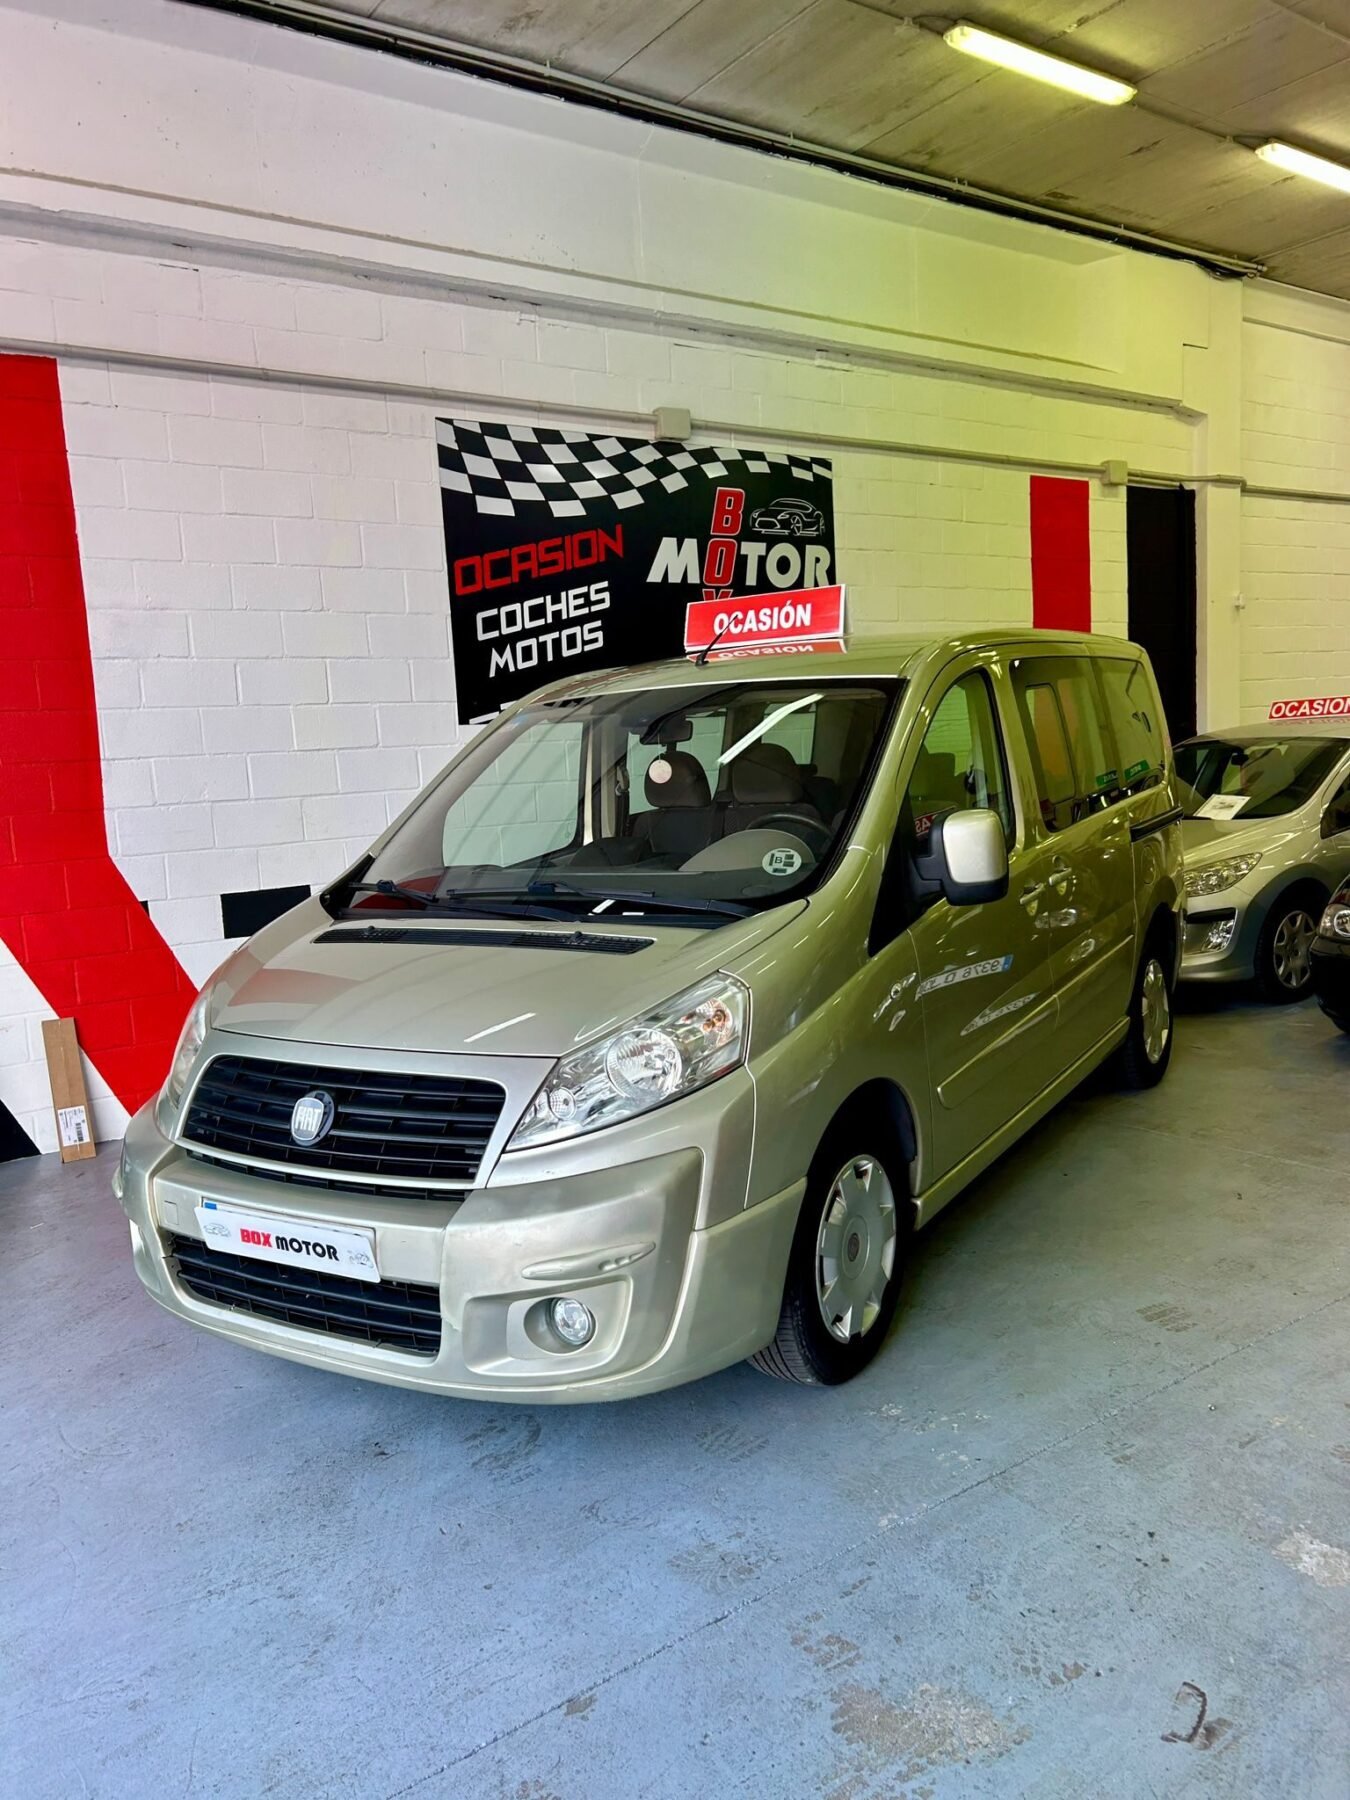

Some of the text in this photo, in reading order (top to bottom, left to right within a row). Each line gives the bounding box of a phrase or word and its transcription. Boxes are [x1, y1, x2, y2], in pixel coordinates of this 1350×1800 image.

[454, 523, 624, 596] OCASION
[646, 537, 831, 588] MOTOR
[476, 580, 611, 641] COCHES
[713, 600, 812, 635] OCASIÓN
[489, 619, 604, 678] MOTOS
[240, 1228, 273, 1248] BOX
